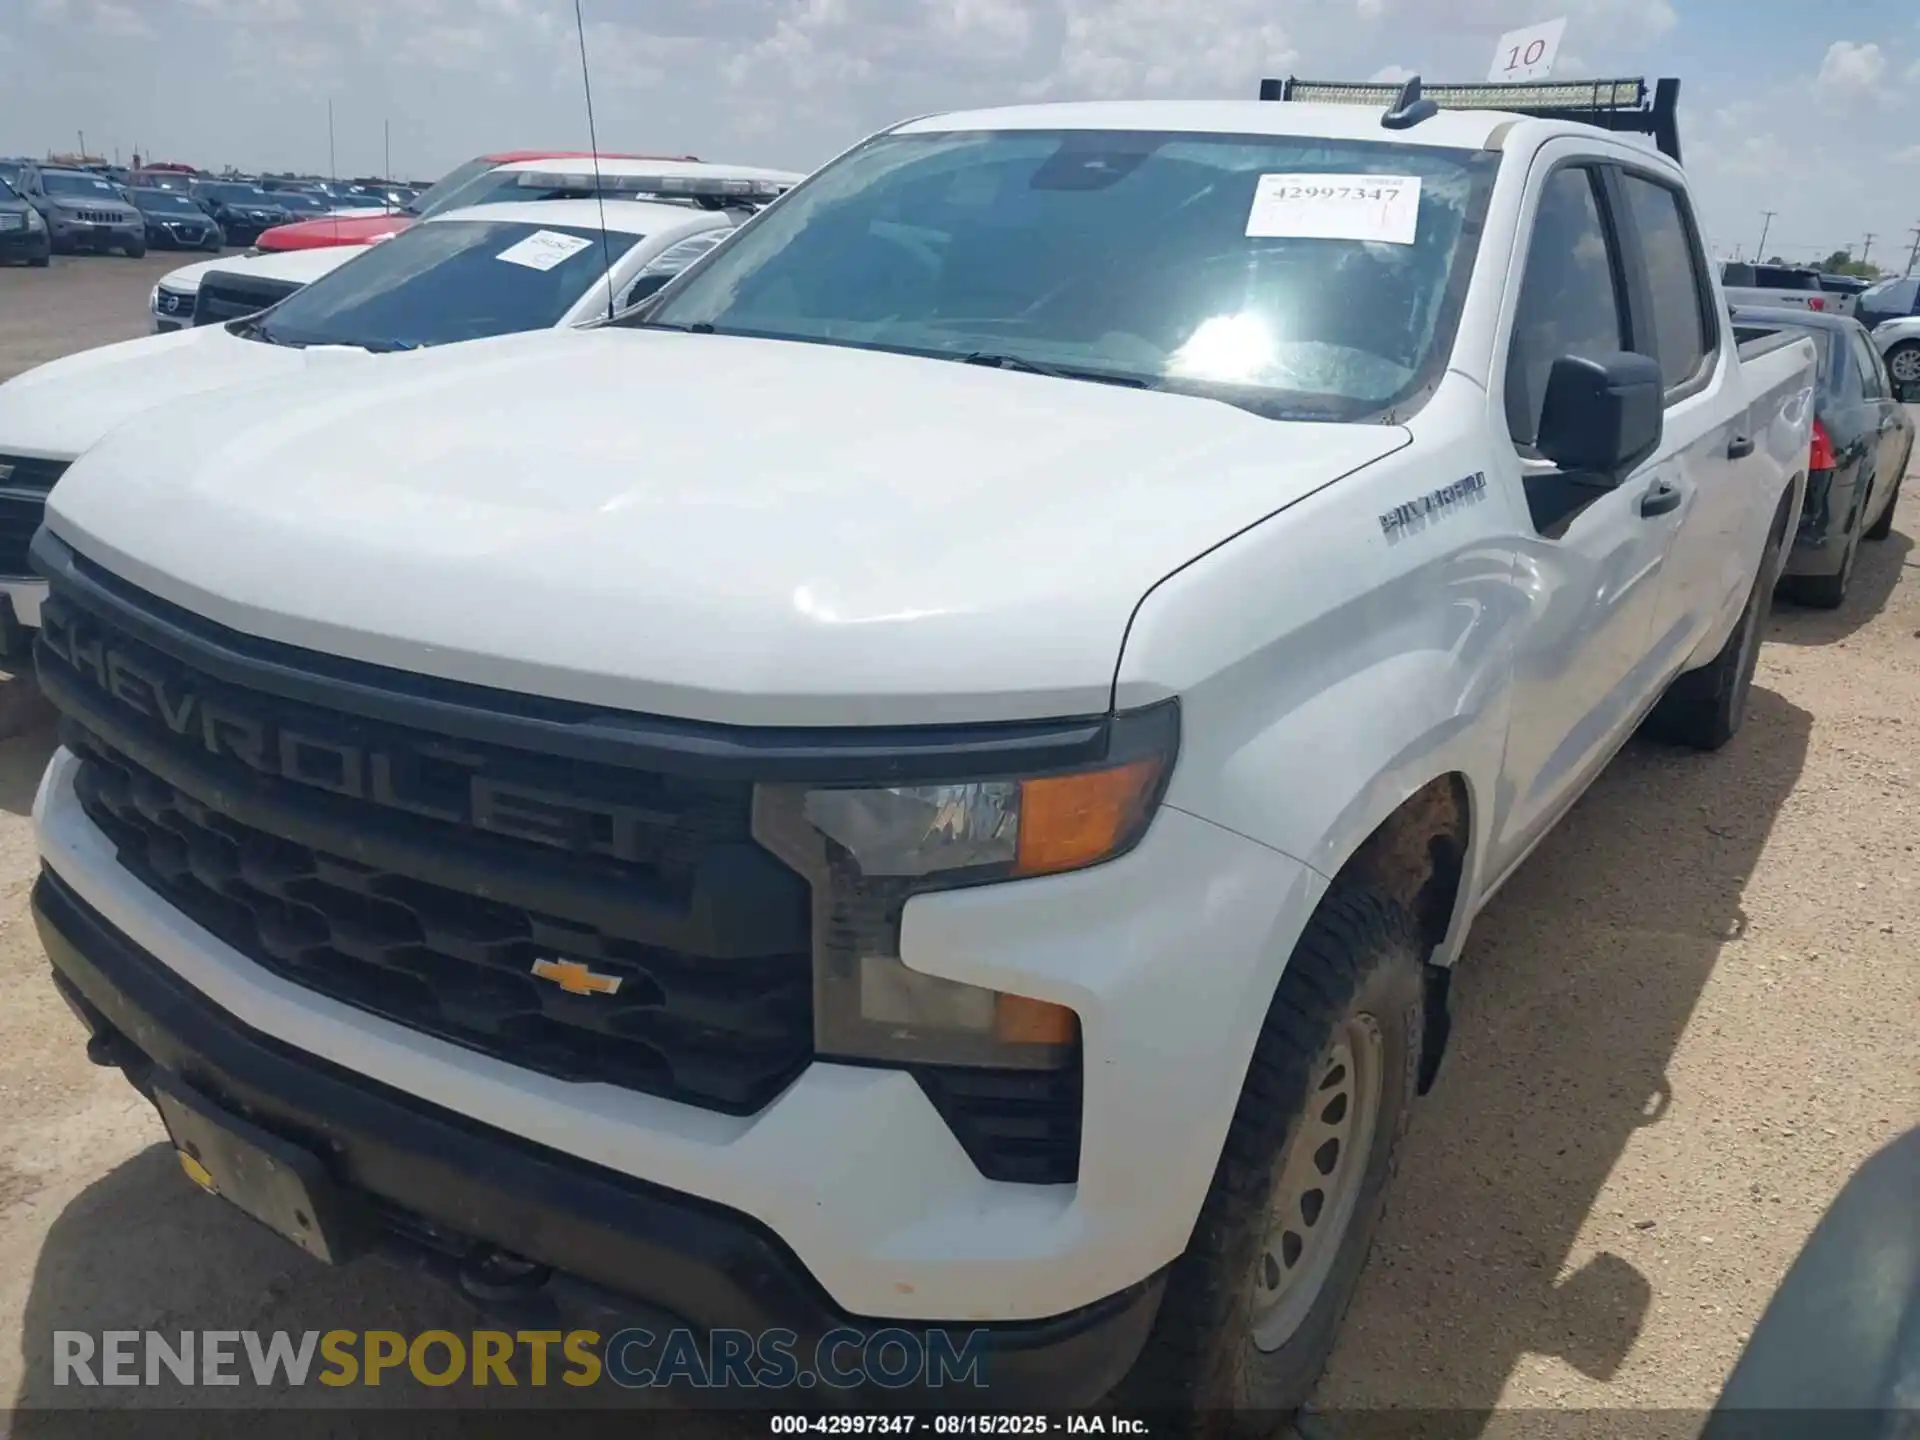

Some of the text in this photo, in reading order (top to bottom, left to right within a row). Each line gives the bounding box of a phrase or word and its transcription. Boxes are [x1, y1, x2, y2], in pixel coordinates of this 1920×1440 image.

[1503, 39, 1546, 72] 10
[1273, 186, 1401, 202] 42997347
[41, 600, 678, 862] CHEVROLET
